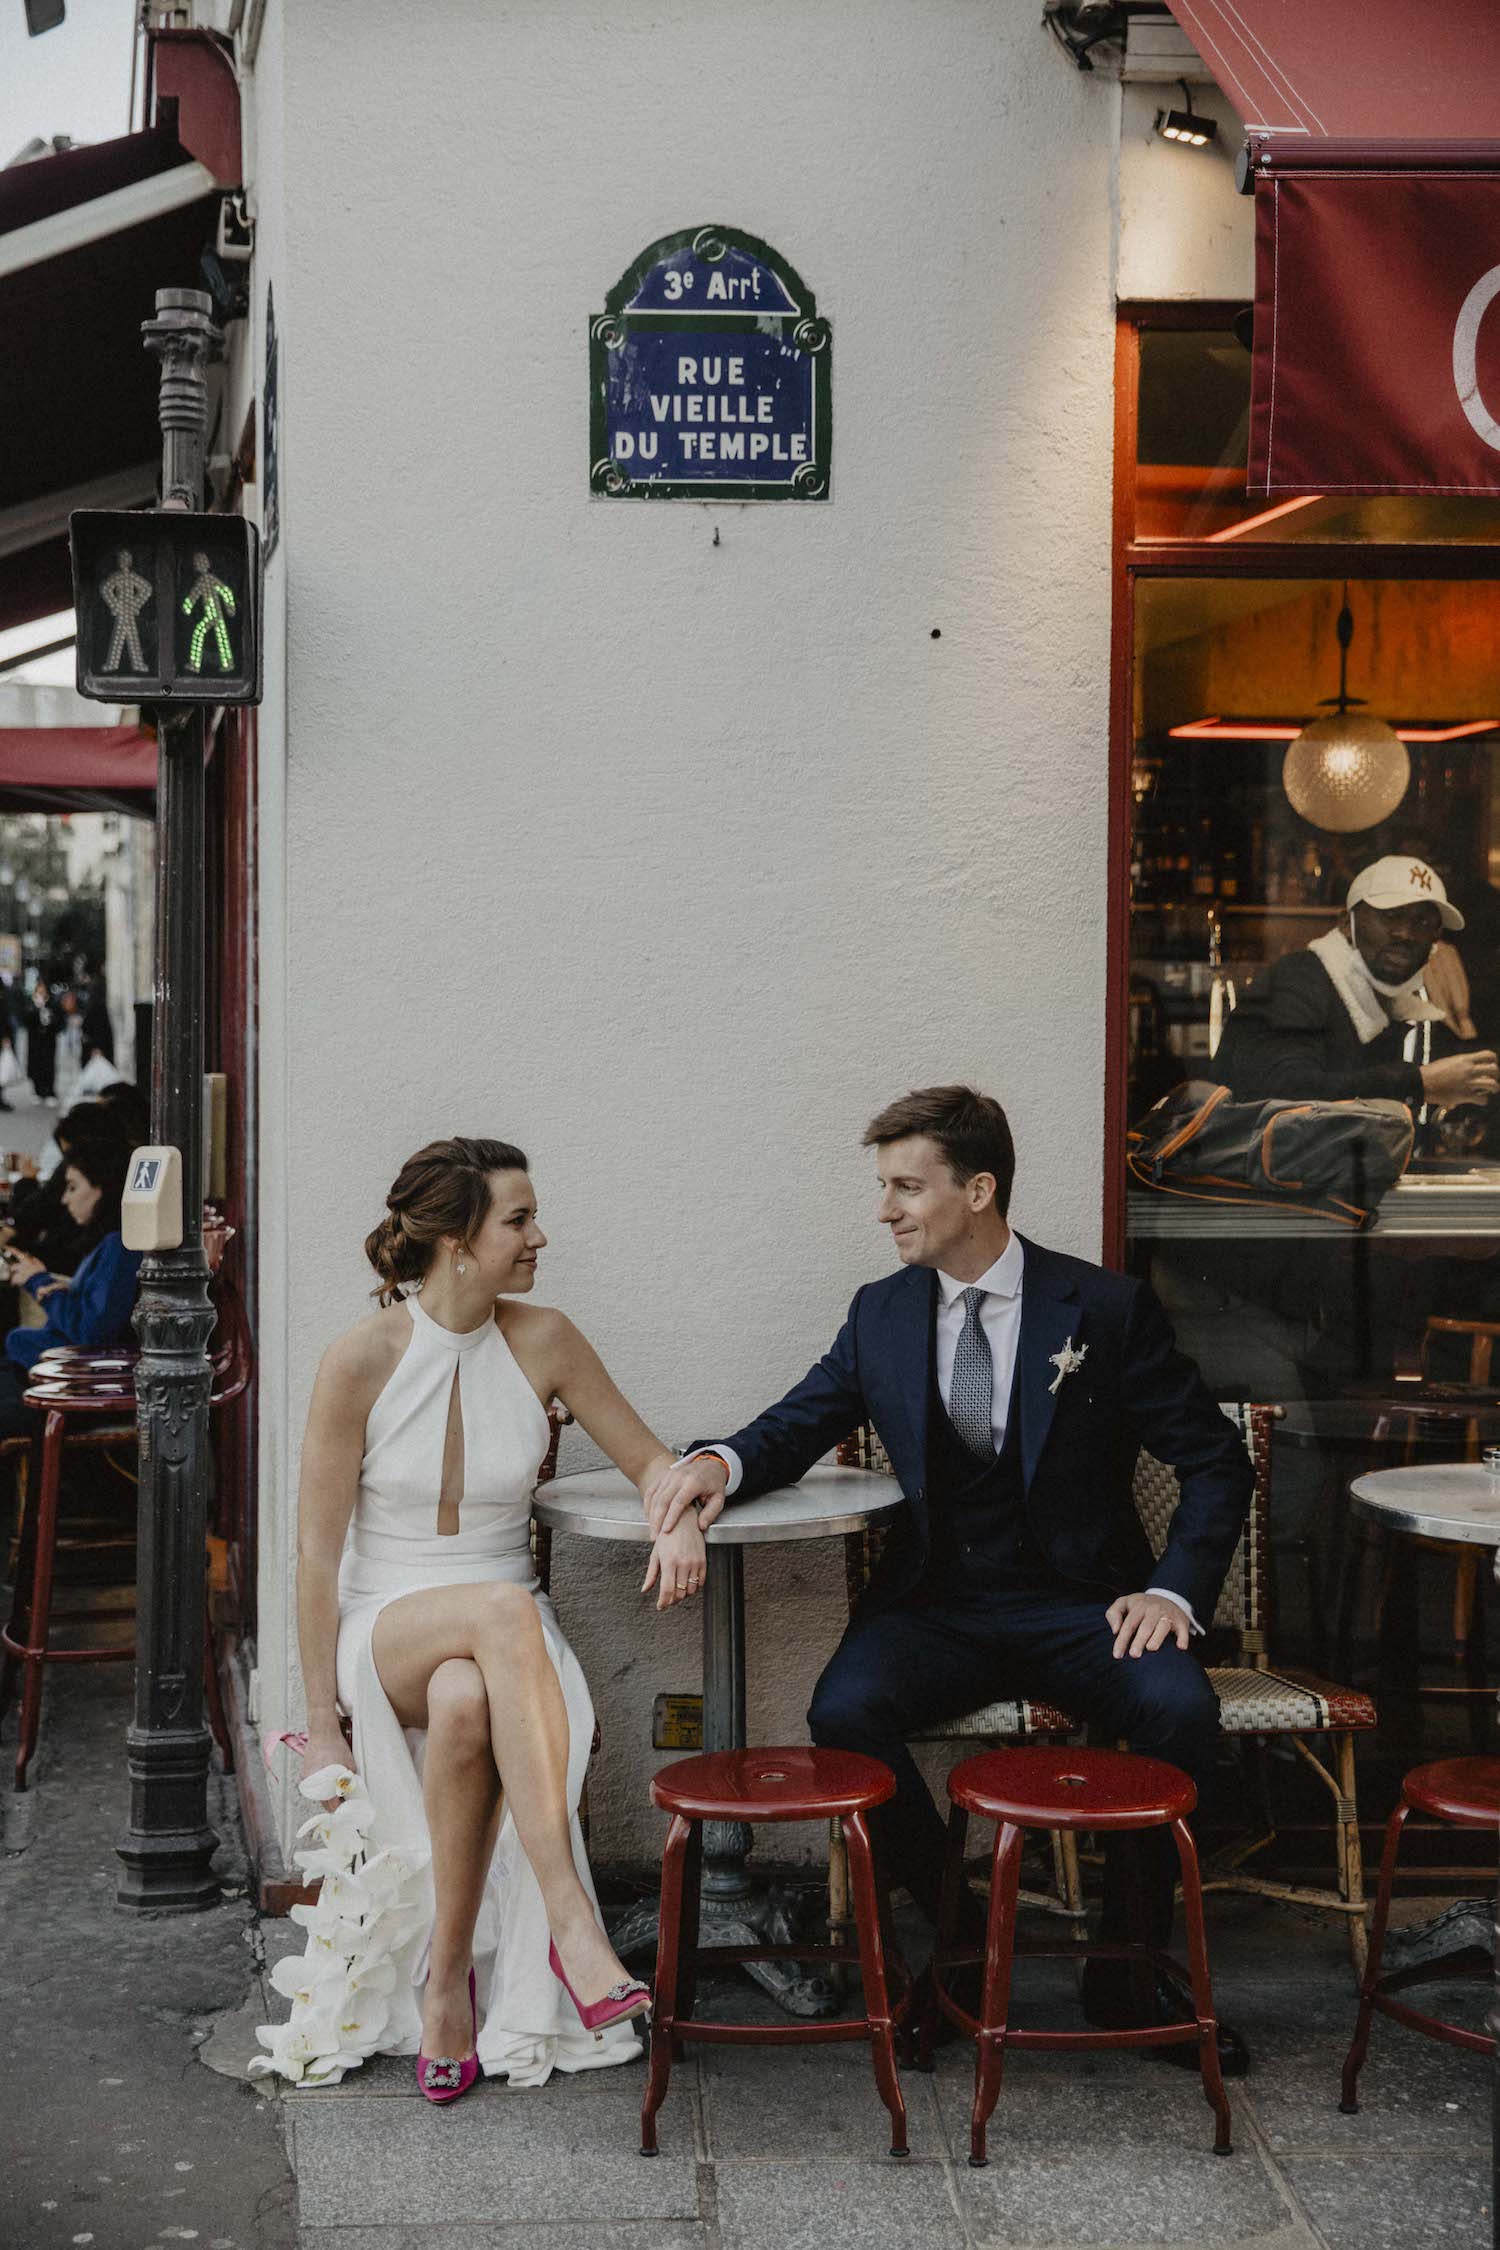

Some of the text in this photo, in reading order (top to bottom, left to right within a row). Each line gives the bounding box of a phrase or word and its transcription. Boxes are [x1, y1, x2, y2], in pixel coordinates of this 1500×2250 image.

[677, 356, 745, 386] RUE
[650, 394, 774, 424] VIEILLE
[615, 431, 807, 461] DU TEMPLE
